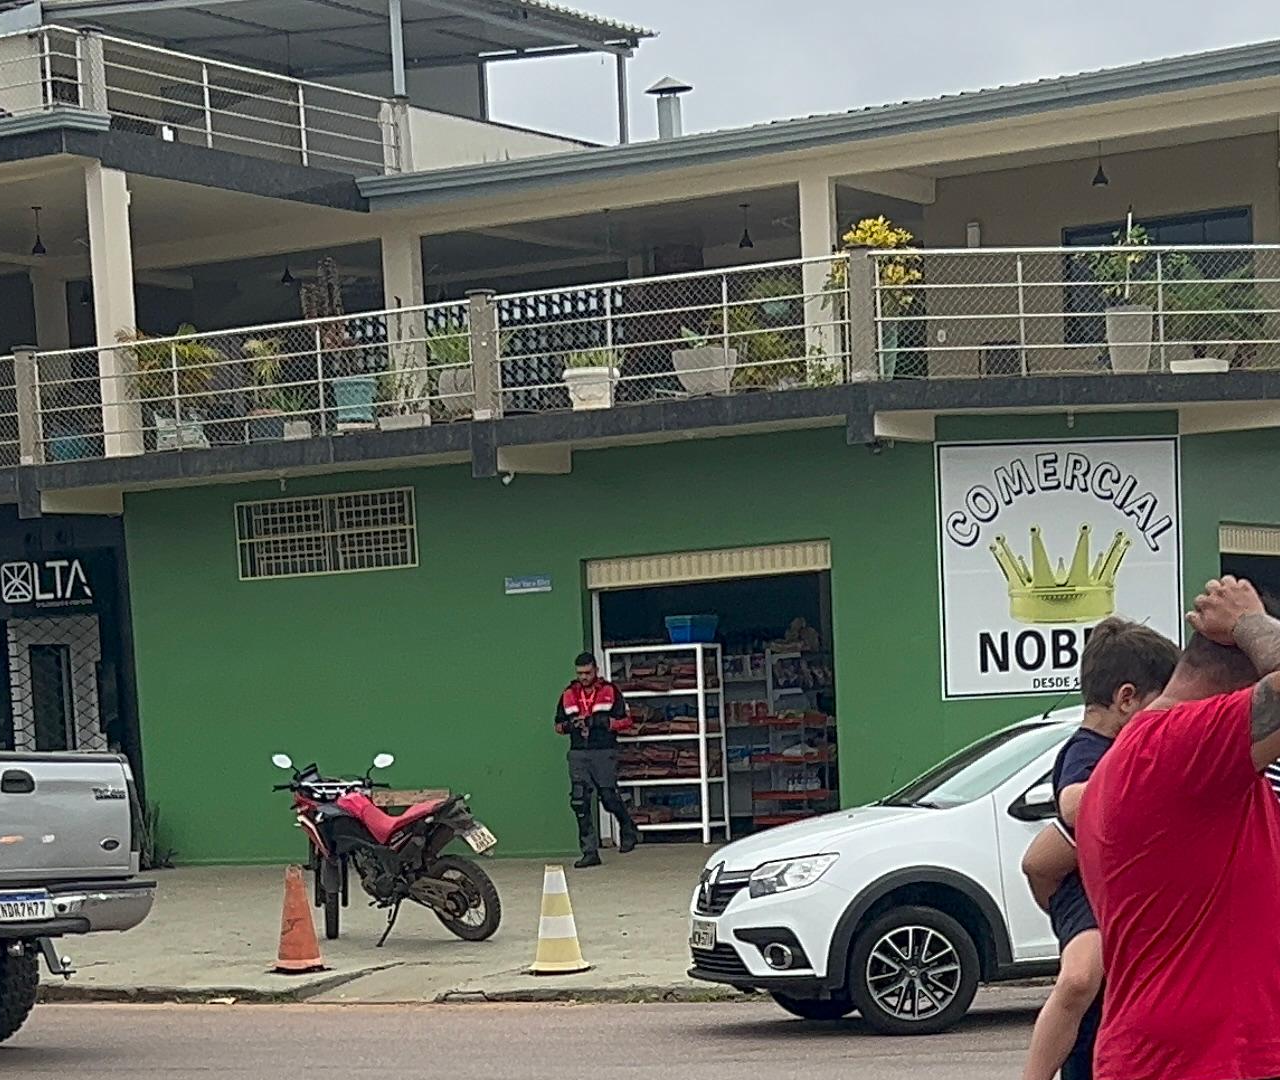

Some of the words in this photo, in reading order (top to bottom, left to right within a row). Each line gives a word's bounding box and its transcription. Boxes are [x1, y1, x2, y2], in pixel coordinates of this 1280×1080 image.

[946, 452, 1173, 552] COMERCIAL
[979, 628, 1094, 673] NOB
[1033, 676, 1070, 689] DESDE
